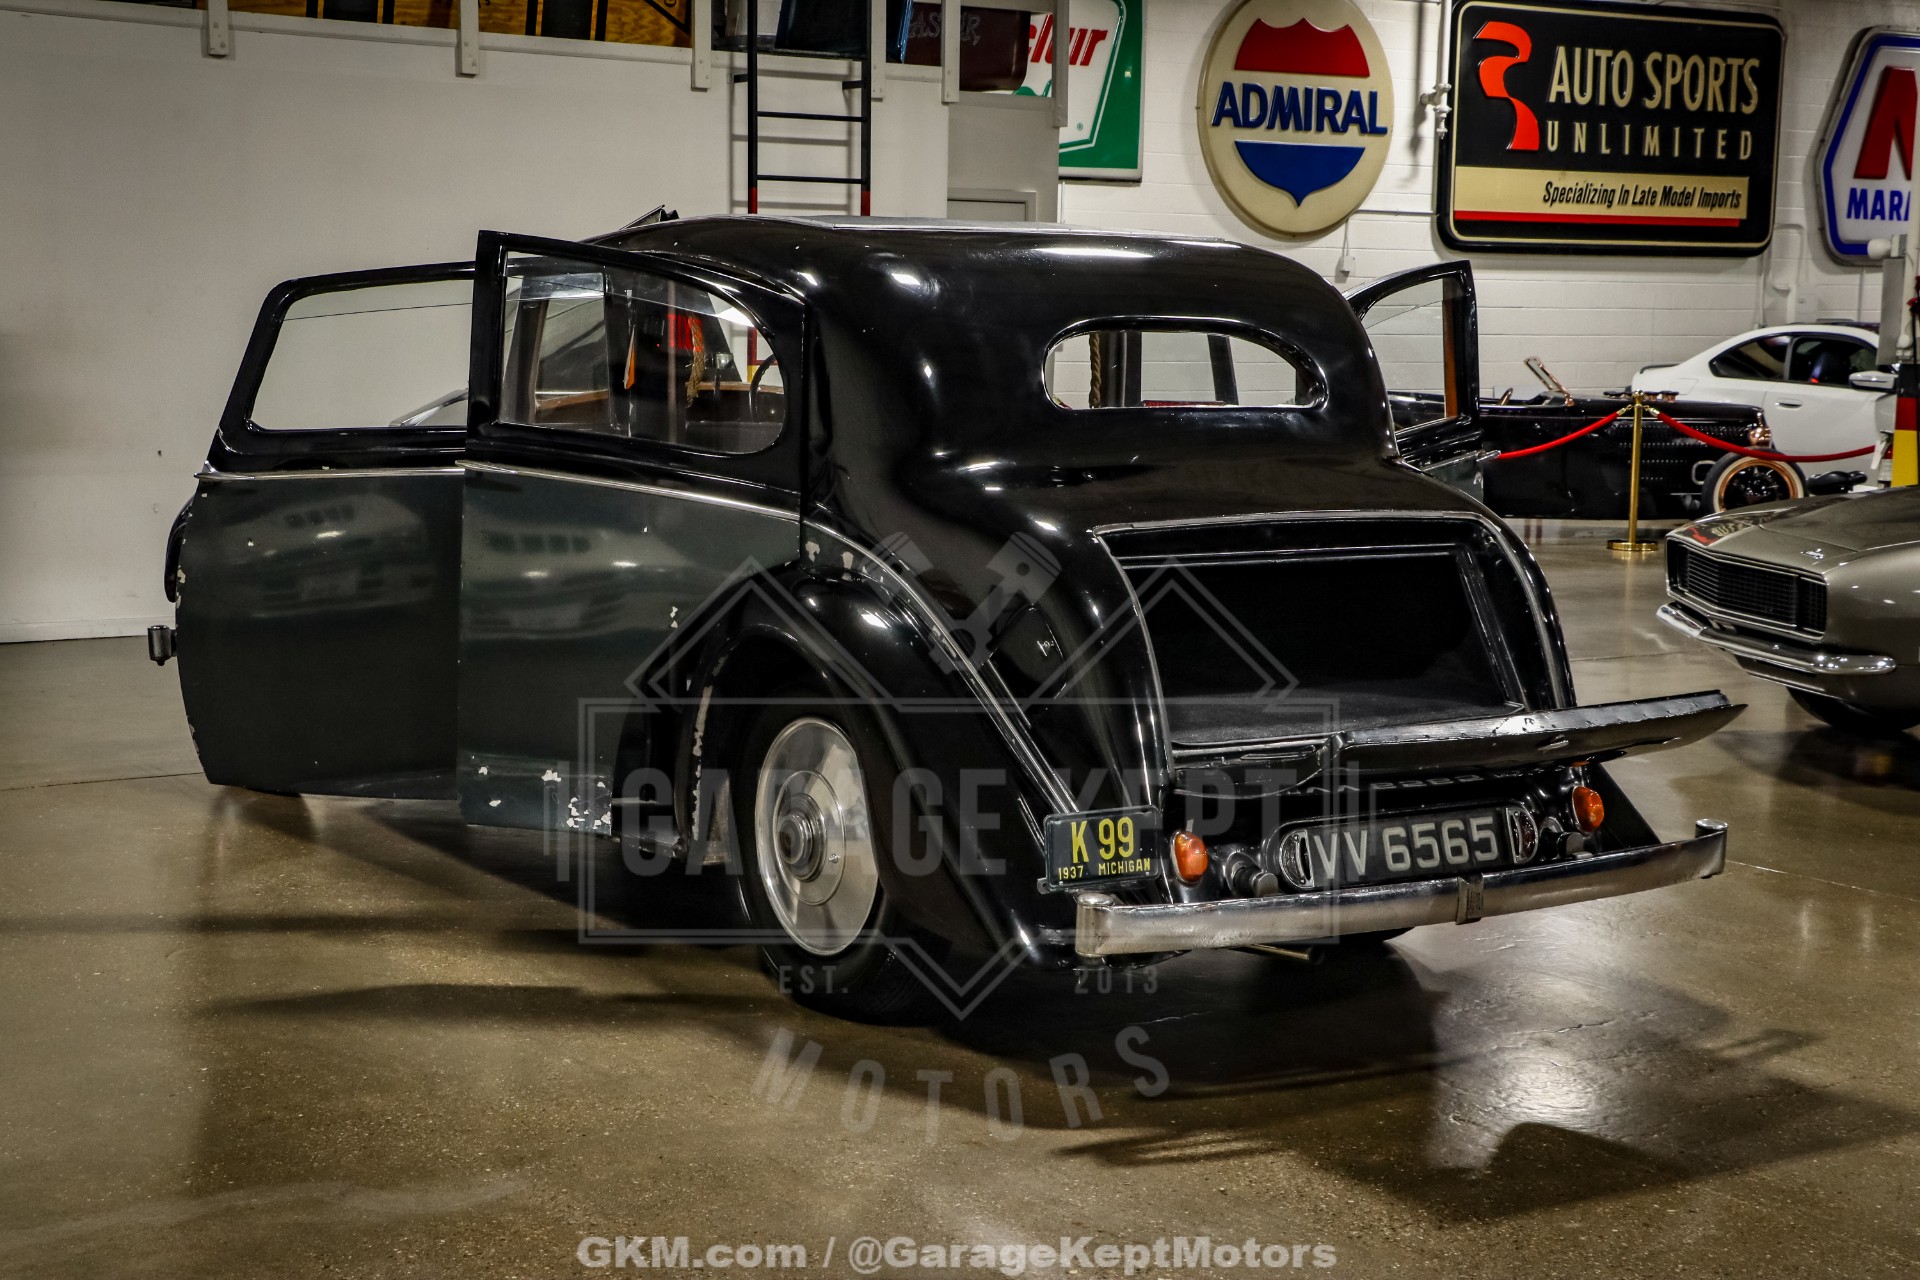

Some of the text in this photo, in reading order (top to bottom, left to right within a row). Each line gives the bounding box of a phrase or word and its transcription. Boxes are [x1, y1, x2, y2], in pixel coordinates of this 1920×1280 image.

[1549, 46, 1760, 114] AUTO SPORTS
[1211, 81, 1388, 135] ADMIRAL
[1547, 120, 1753, 160] UNLIMITED
[1543, 181, 1742, 212] Specializing In Late Model Imports
[1071, 816, 1134, 864] K 99
[1313, 816, 1499, 879] VV 6565
[1058, 857, 1151, 880] 1937 MICHIGAN
